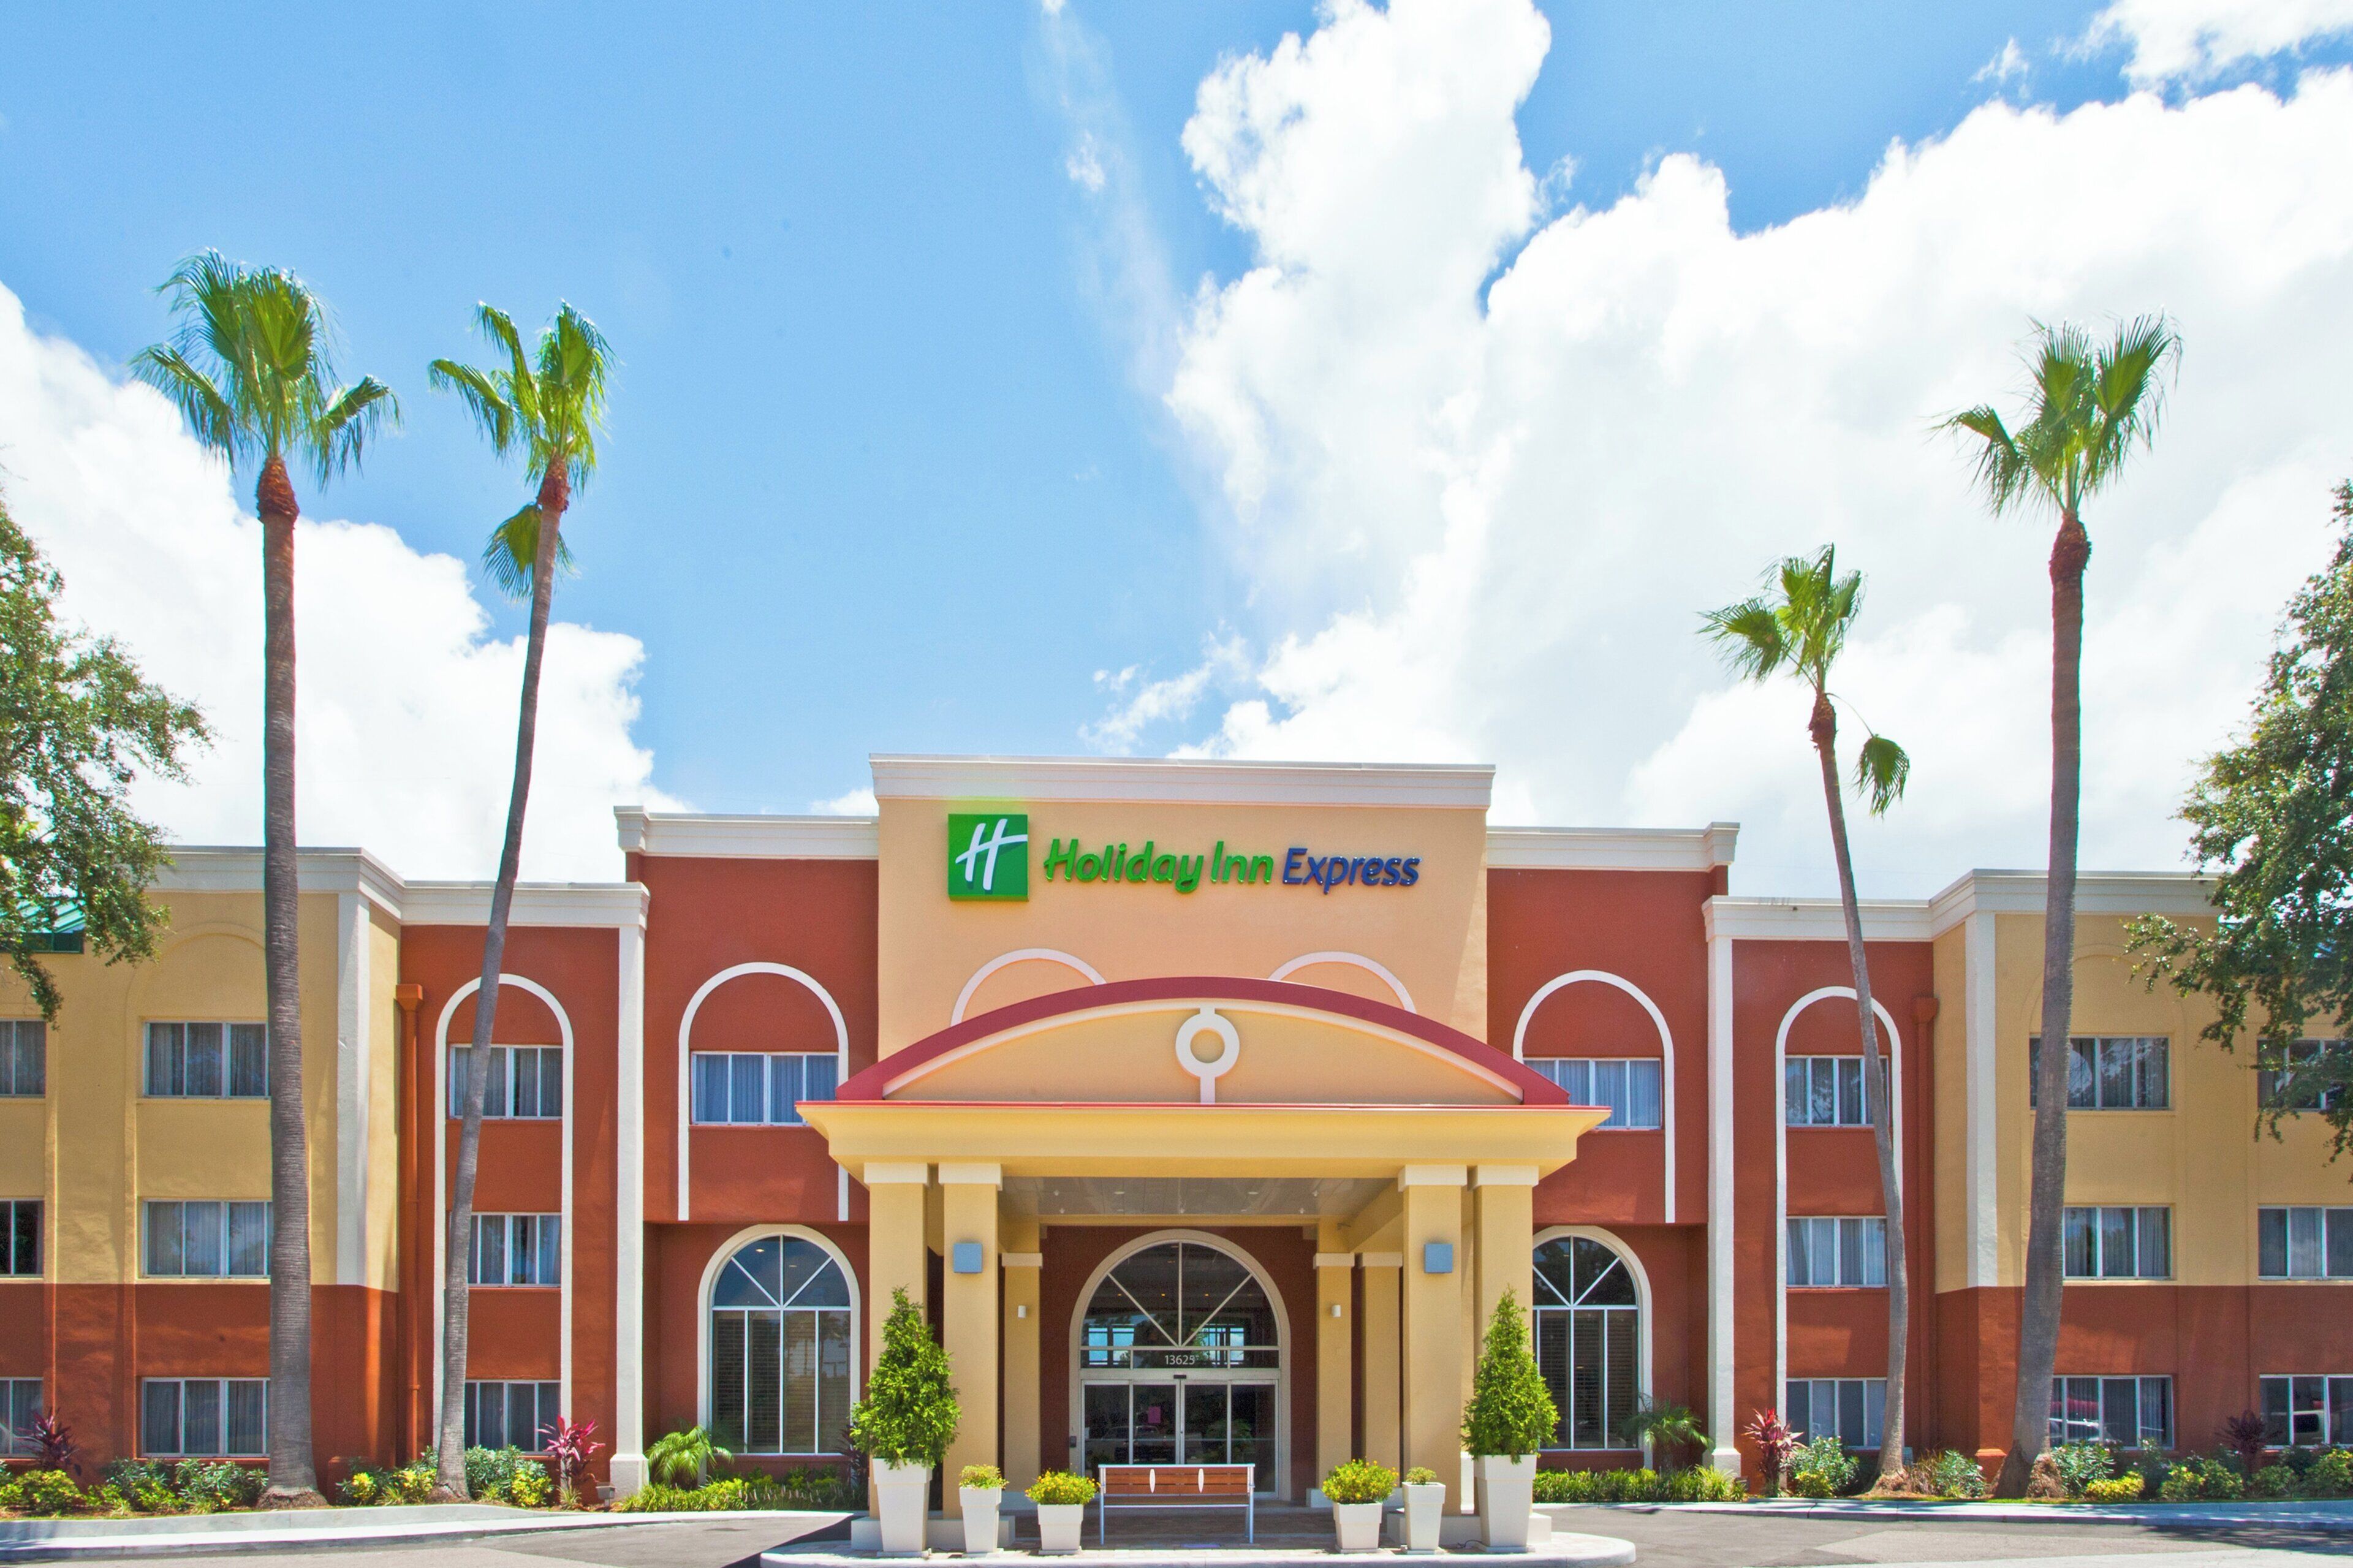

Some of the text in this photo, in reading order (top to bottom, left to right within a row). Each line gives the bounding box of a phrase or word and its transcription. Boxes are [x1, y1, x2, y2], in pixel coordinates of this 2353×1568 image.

[1044, 838, 1422, 895] Holiday Inn Express
[1164, 1355, 1195, 1365] 13625
